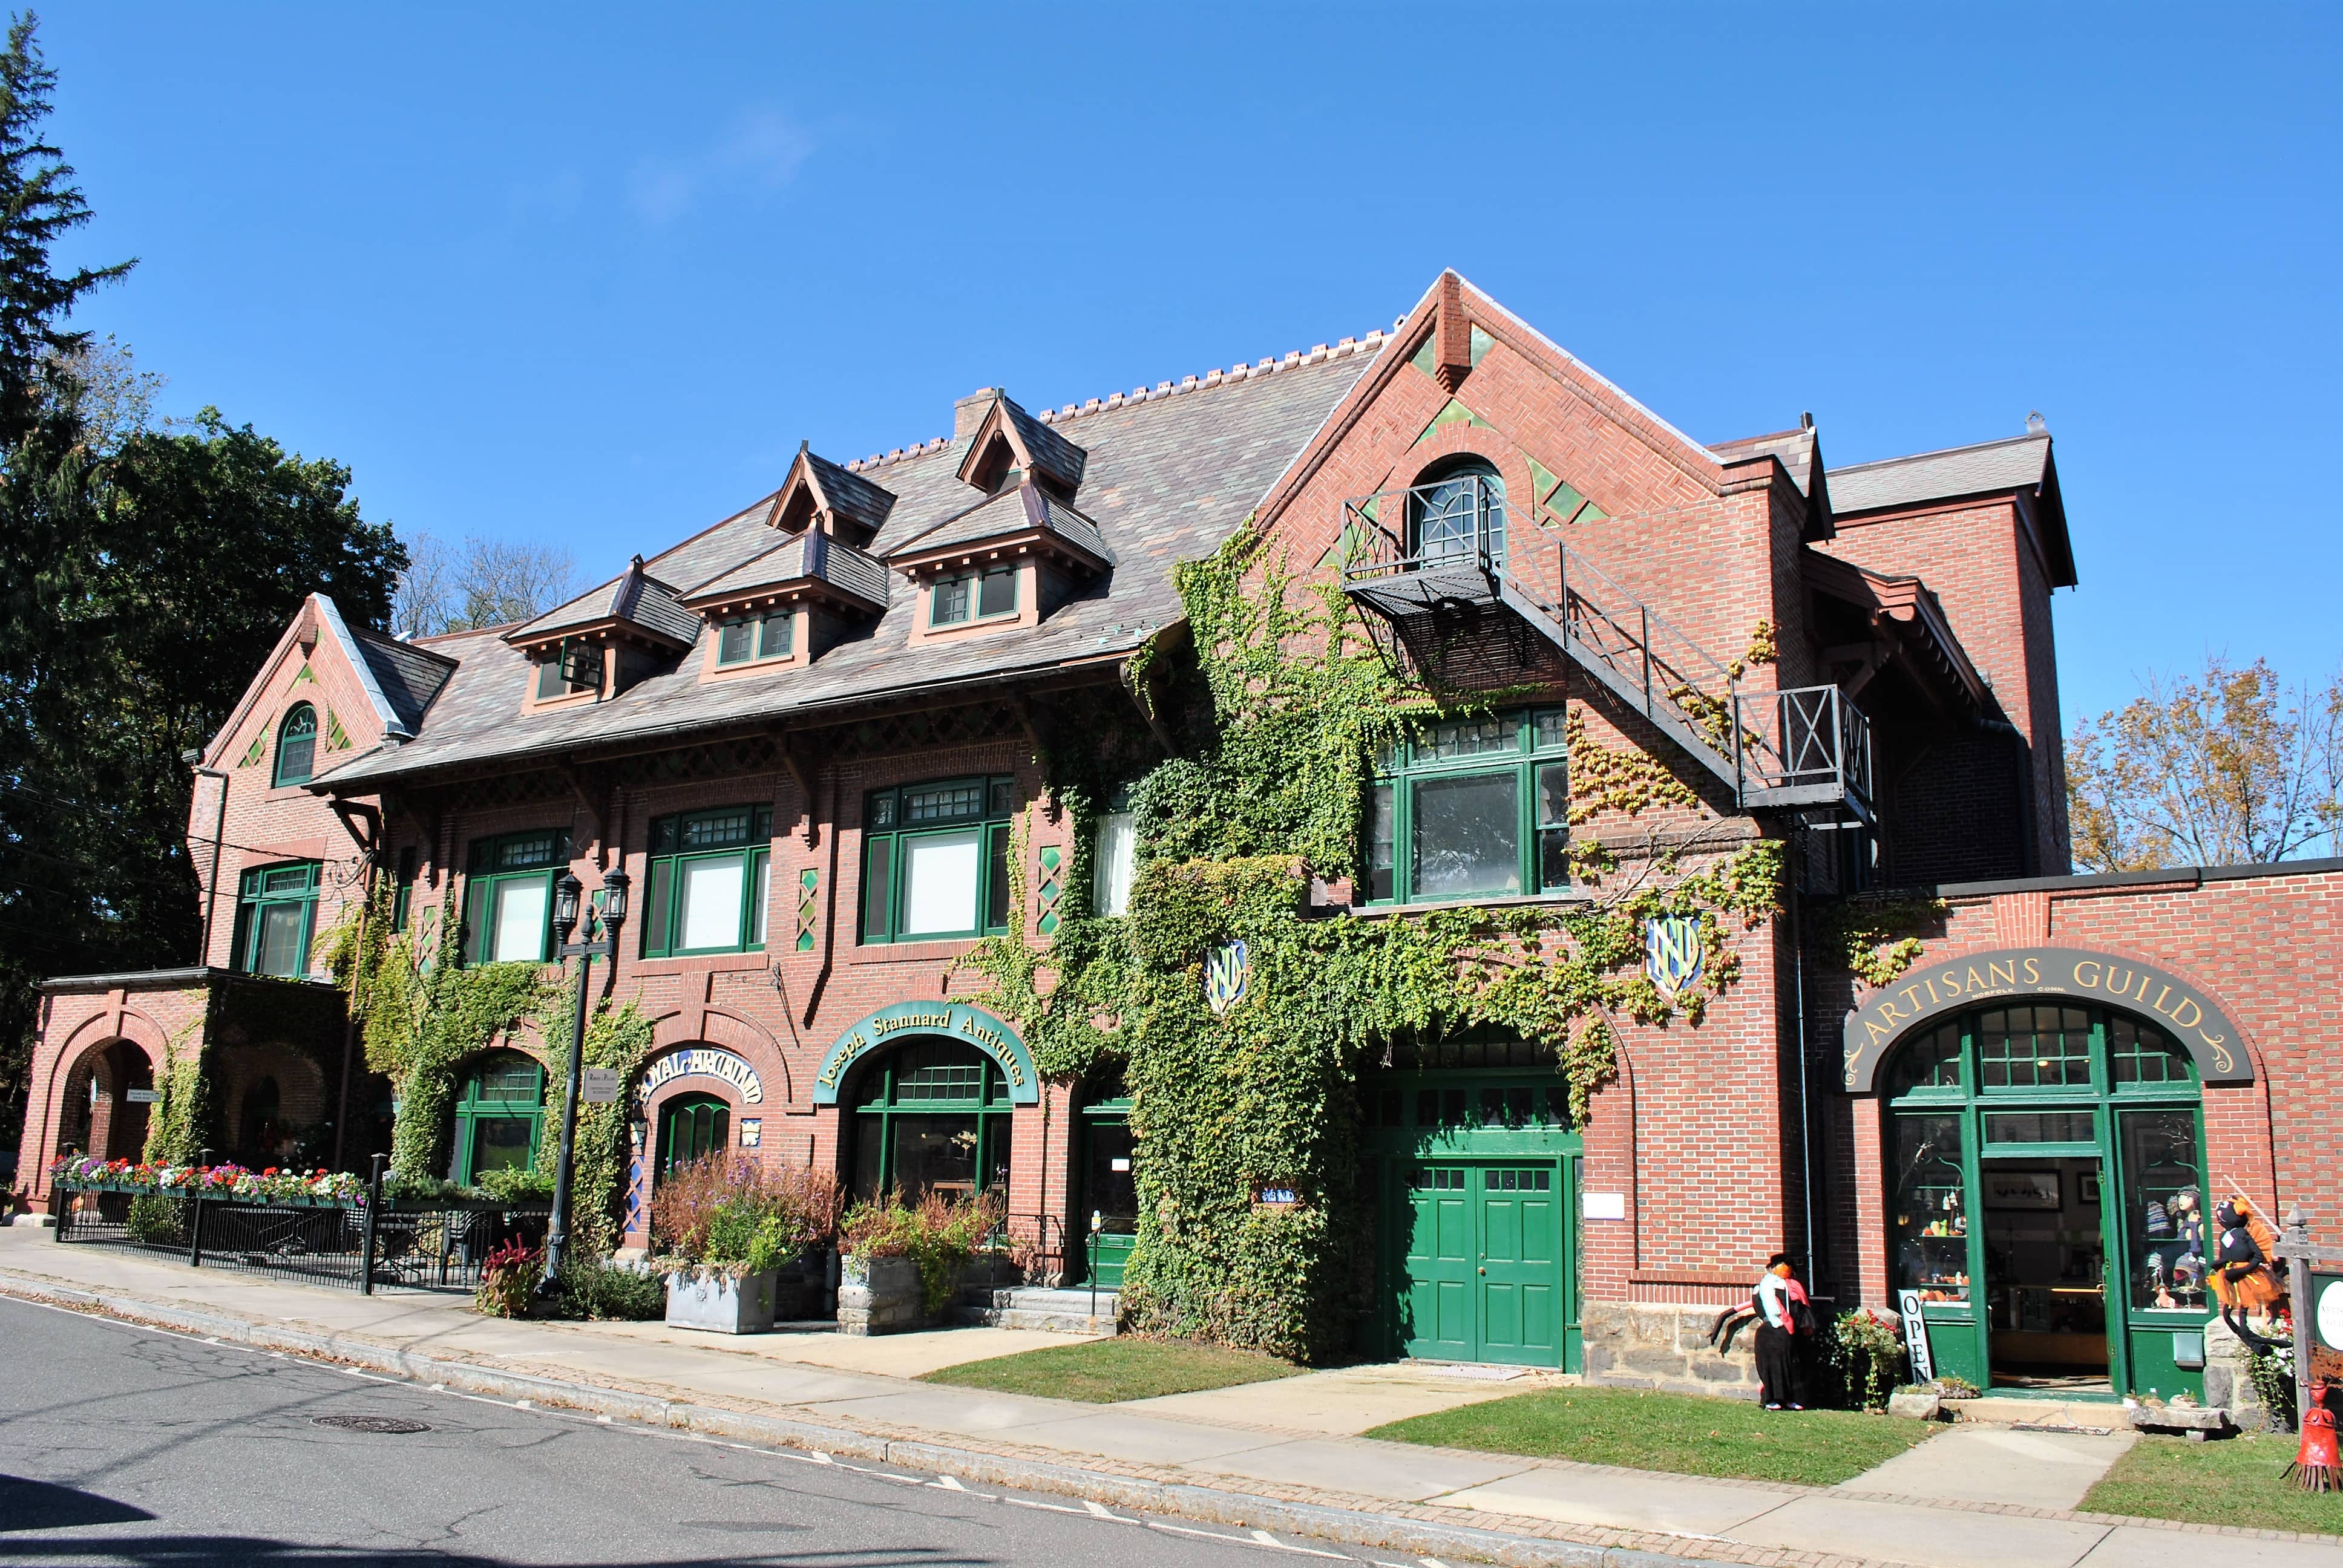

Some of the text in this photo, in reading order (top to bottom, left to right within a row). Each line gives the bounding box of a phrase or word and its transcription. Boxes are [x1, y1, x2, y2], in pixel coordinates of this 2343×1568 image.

[1863, 958, 2202, 1046] ARTISANS GUILD
[818, 1009, 1024, 1089] Joseph Stannard Antiques
[1904, 1295, 1928, 1385] OPEN
